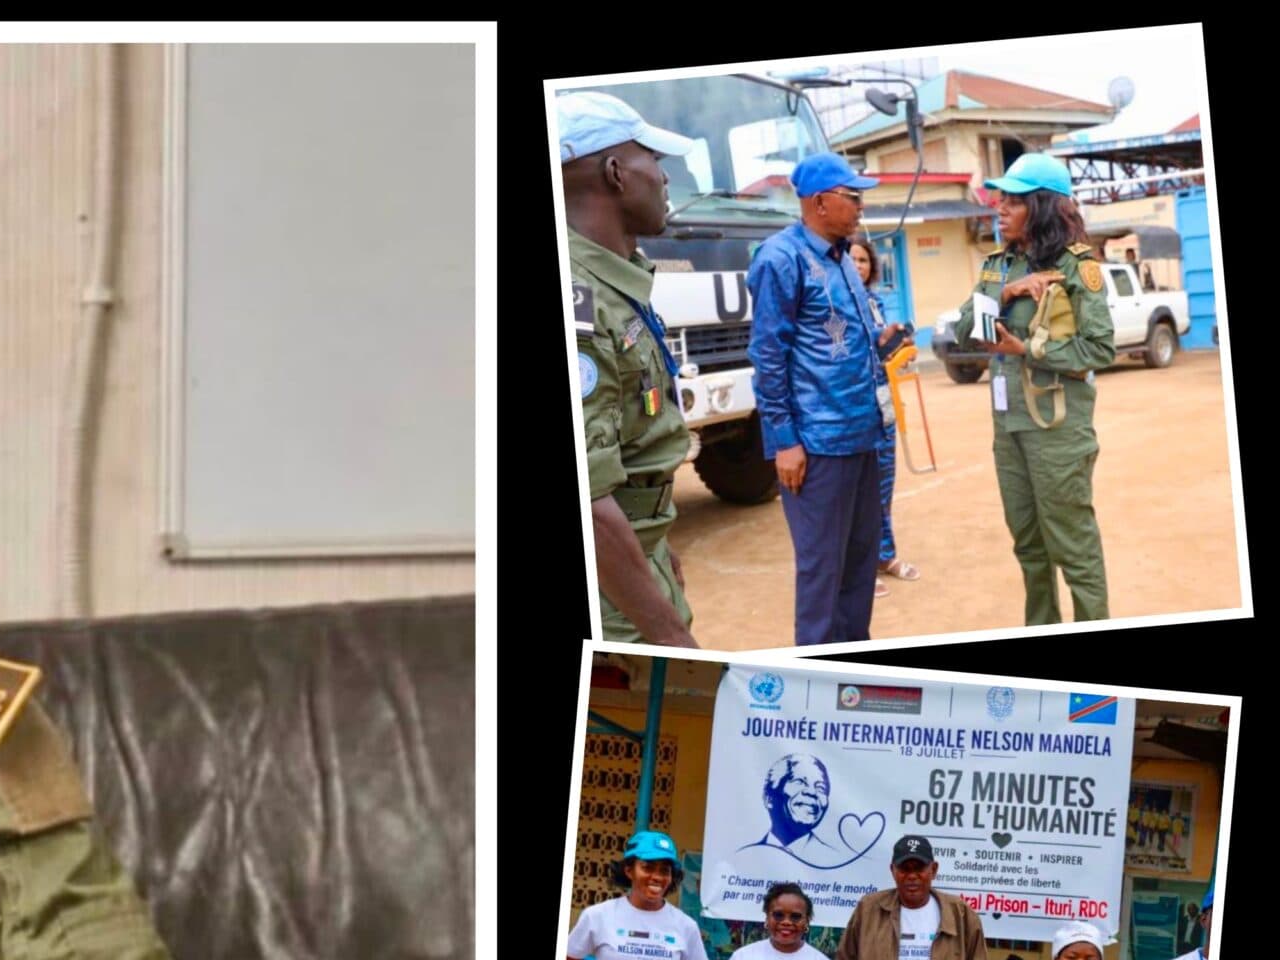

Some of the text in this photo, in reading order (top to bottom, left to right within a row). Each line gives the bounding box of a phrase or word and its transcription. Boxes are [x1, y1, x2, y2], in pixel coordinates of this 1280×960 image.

[713, 273, 748, 322] U
[742, 717, 1112, 757] JOURNÉE INTERNATIONALE NELSON MANDELA
[900, 746, 966, 759] 18 JUILLET
[928, 768, 1096, 809] 67 MINUTES
[899, 799, 965, 828] POUR
[932, 847, 1083, 866] RVIR SOUTENIR INSPIRER
[953, 860, 1039, 875] Solidarité avec les
[728, 875, 765, 888] Chacun
[796, 881, 831, 894] hanger
[832, 881, 842, 892] le
[843, 884, 878, 894] monde
[981, 875, 1015, 888] privées
[1017, 877, 1029, 887] de
[1030, 878, 1061, 890] liberté
[723, 890, 857, 908] par un nveillanc
[985, 894, 1029, 914] Prison
[1045, 897, 1076, 920] Ituri,
[1079, 900, 1108, 919] RDC
[618, 945, 643, 955] NELSON
